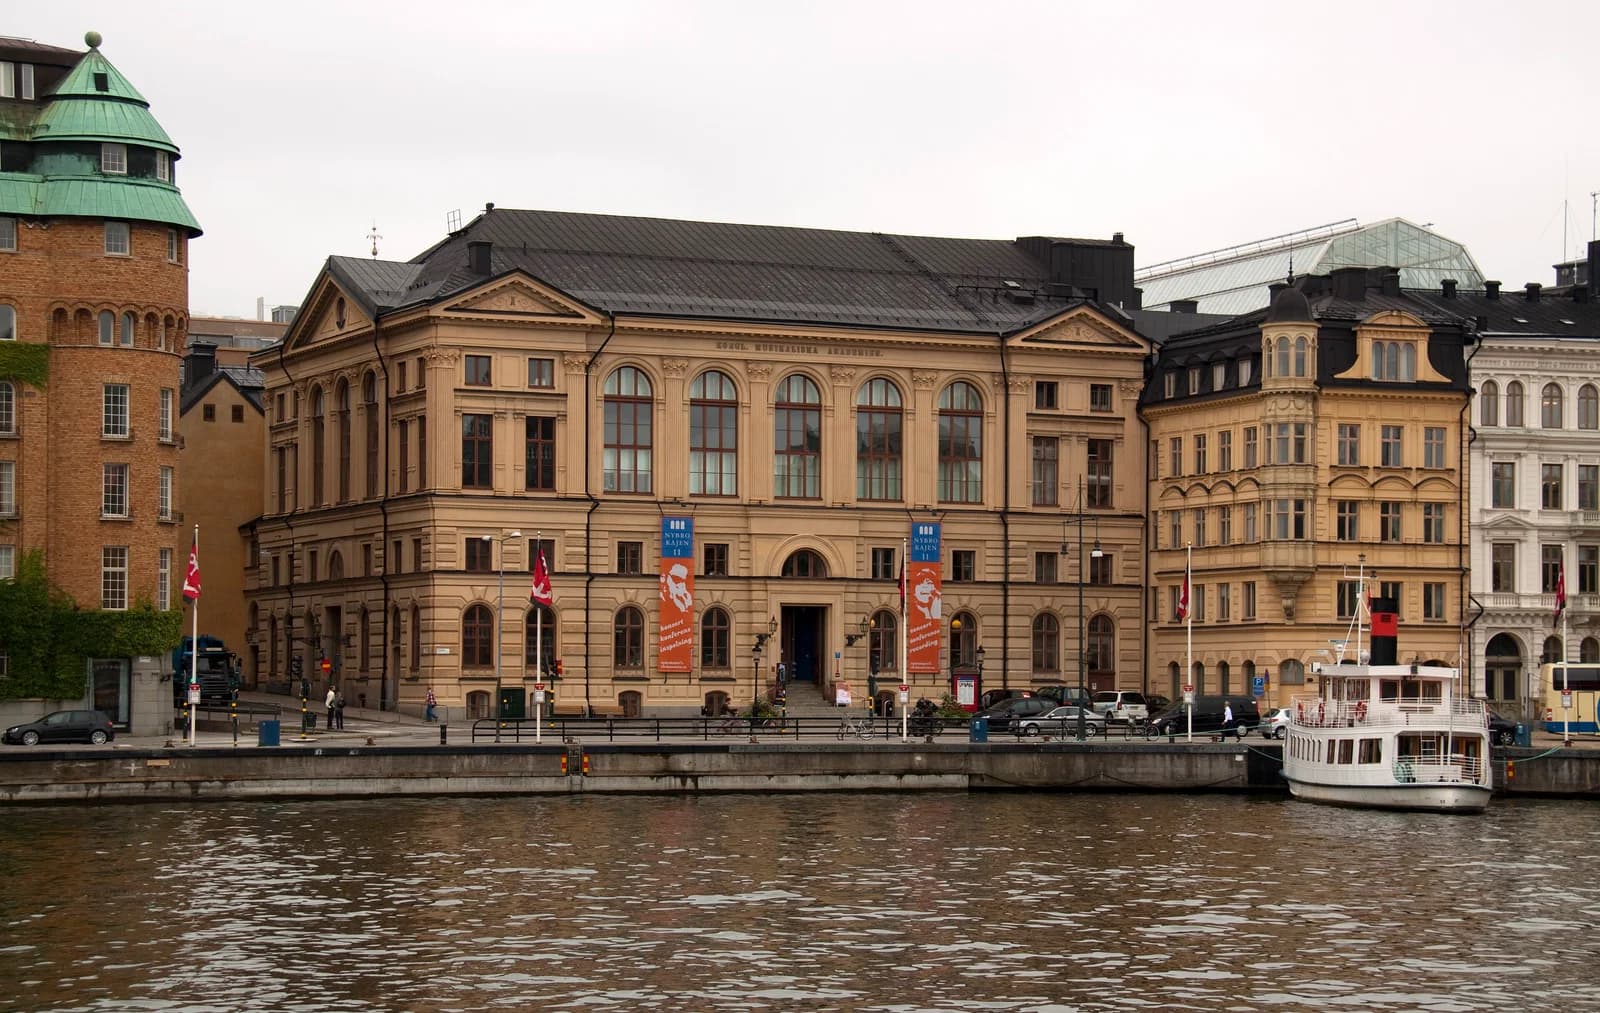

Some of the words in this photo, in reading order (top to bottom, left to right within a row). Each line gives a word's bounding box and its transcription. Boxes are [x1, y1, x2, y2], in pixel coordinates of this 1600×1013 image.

[665, 540, 689, 548] KAJEN
[915, 544, 937, 552] KAJEN
[660, 618, 684, 632] konsert
[660, 627, 691, 642] konferens
[660, 638, 692, 653] inspelning
[909, 640, 938, 654] recording
